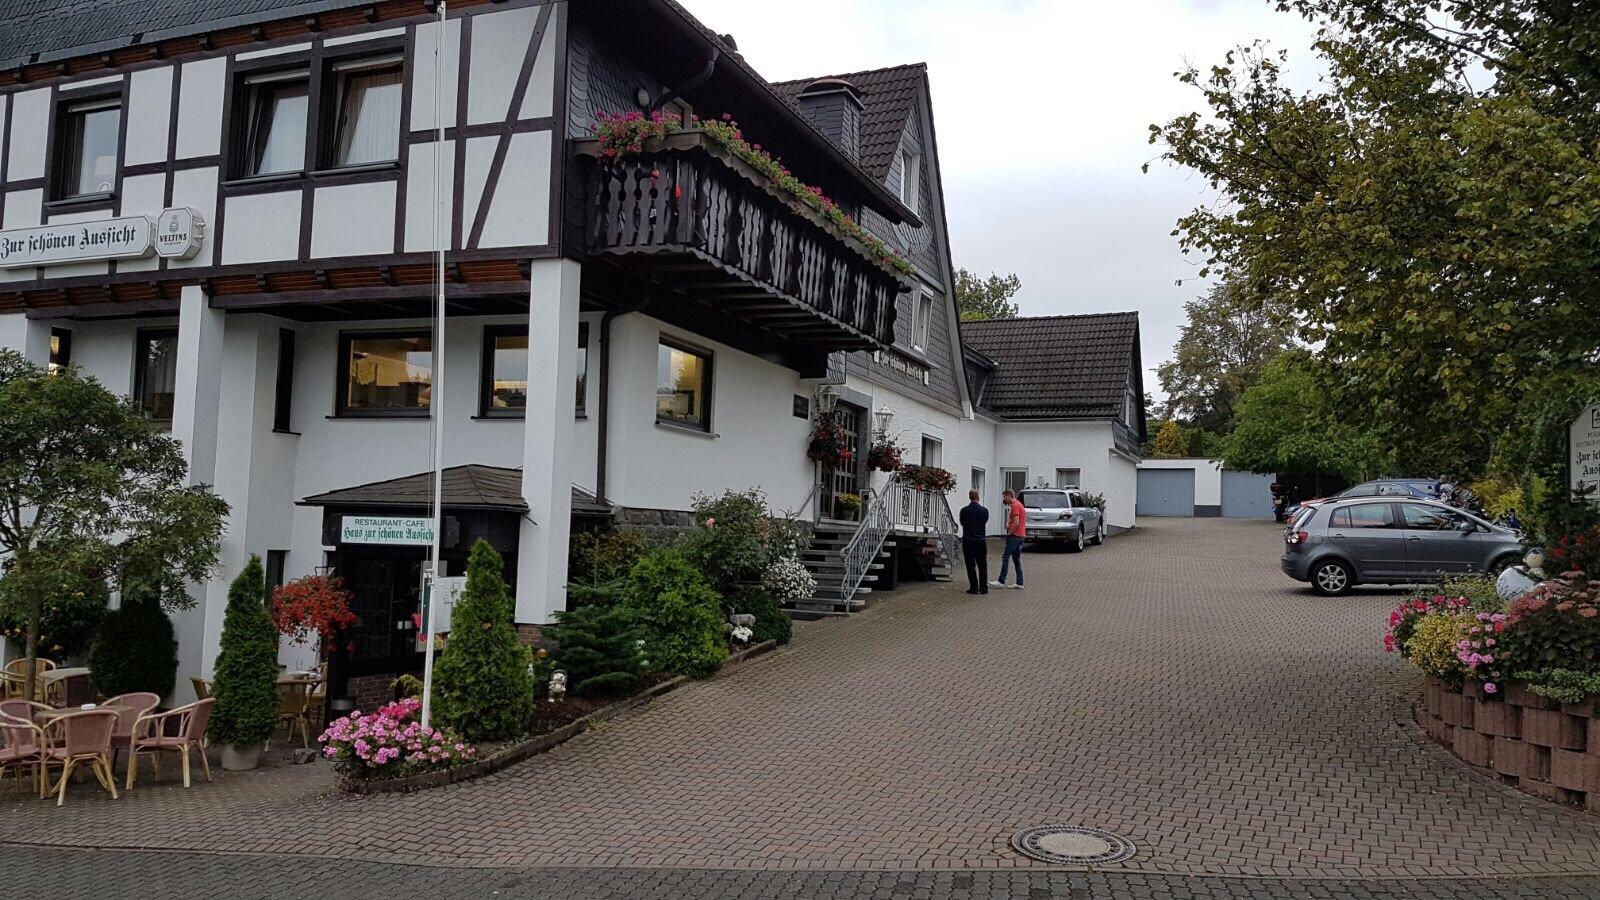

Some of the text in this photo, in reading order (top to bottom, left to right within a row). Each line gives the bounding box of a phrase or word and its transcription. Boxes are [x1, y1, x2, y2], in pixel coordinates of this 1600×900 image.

[160, 233, 187, 242] VELTINS
[0, 237, 24, 260] Zur
[344, 527, 363, 539] Haus
